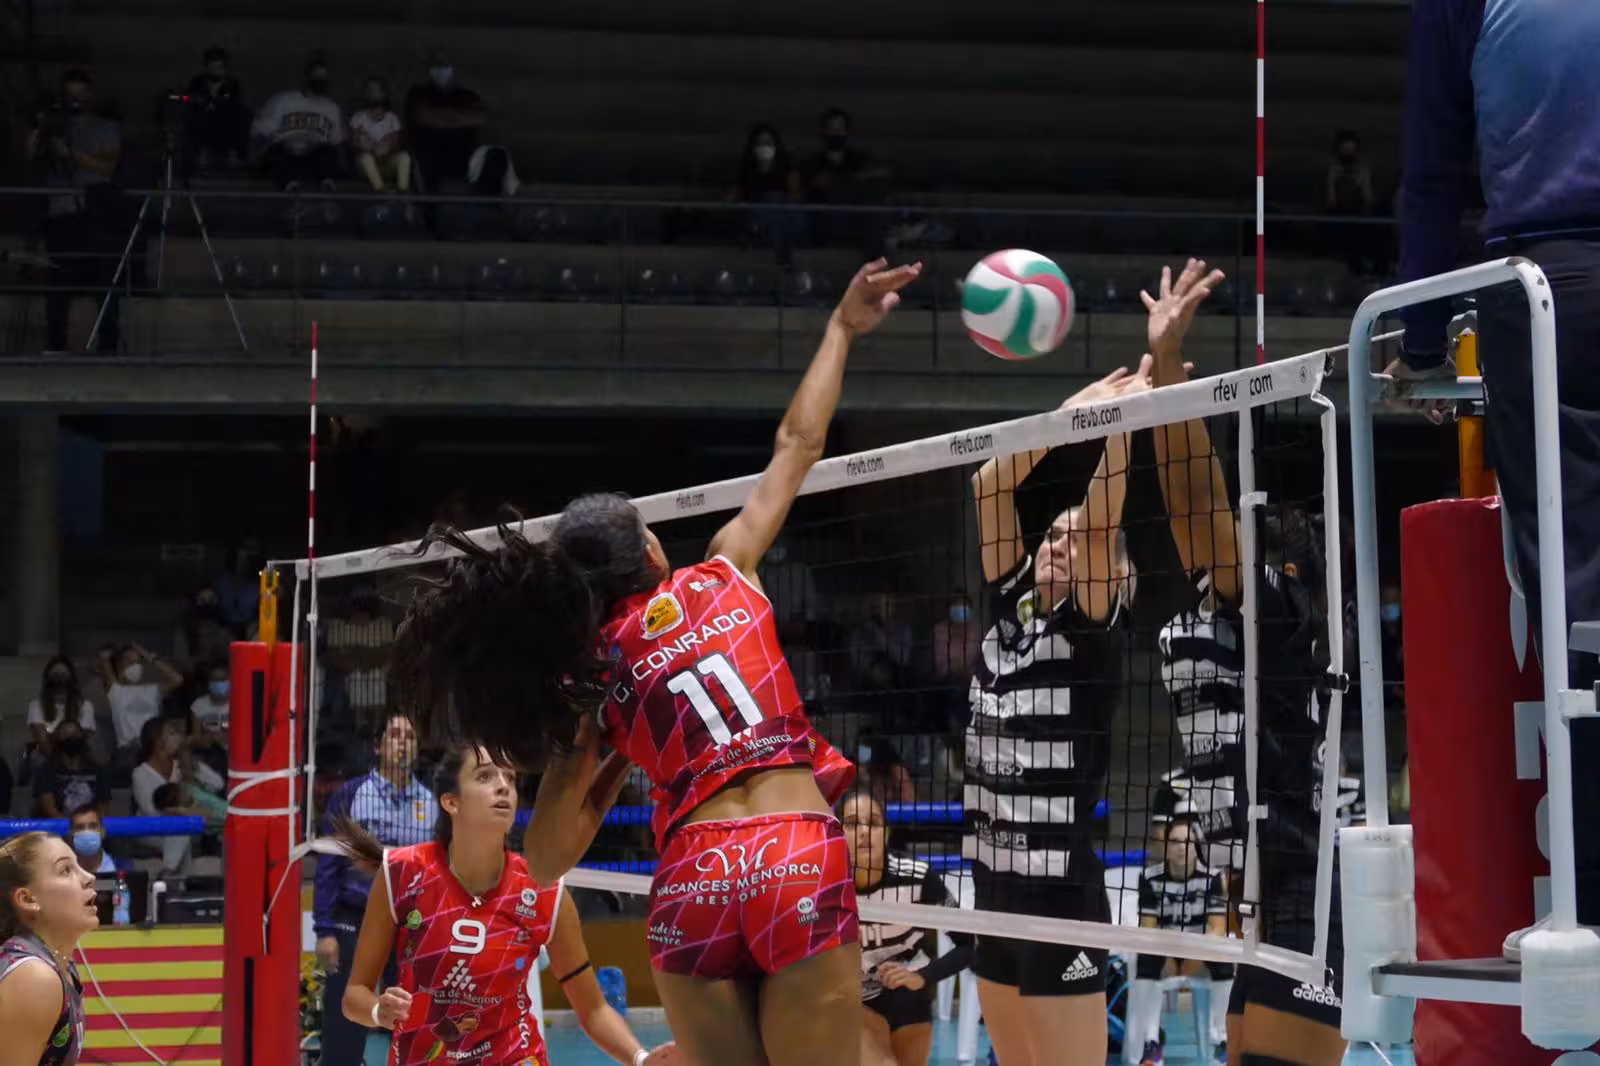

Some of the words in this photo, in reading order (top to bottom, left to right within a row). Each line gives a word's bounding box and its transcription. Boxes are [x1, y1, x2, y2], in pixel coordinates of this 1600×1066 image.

[1072, 406, 1122, 431] rfevb.com
[950, 432, 993, 456] rfevb.com
[846, 455, 884, 477] rfevb.com
[631, 608, 751, 681] CONRADO
[666, 653, 764, 750] 11
[726, 748, 742, 761] de
[742, 734, 793, 753] Menorca
[656, 880, 731, 898] VACANCES
[736, 863, 822, 888] MENORCA
[449, 918, 487, 955] 9
[1062, 966, 1099, 982] adidas
[448, 988, 461, 998] de
[1293, 986, 1342, 1009] adidas
